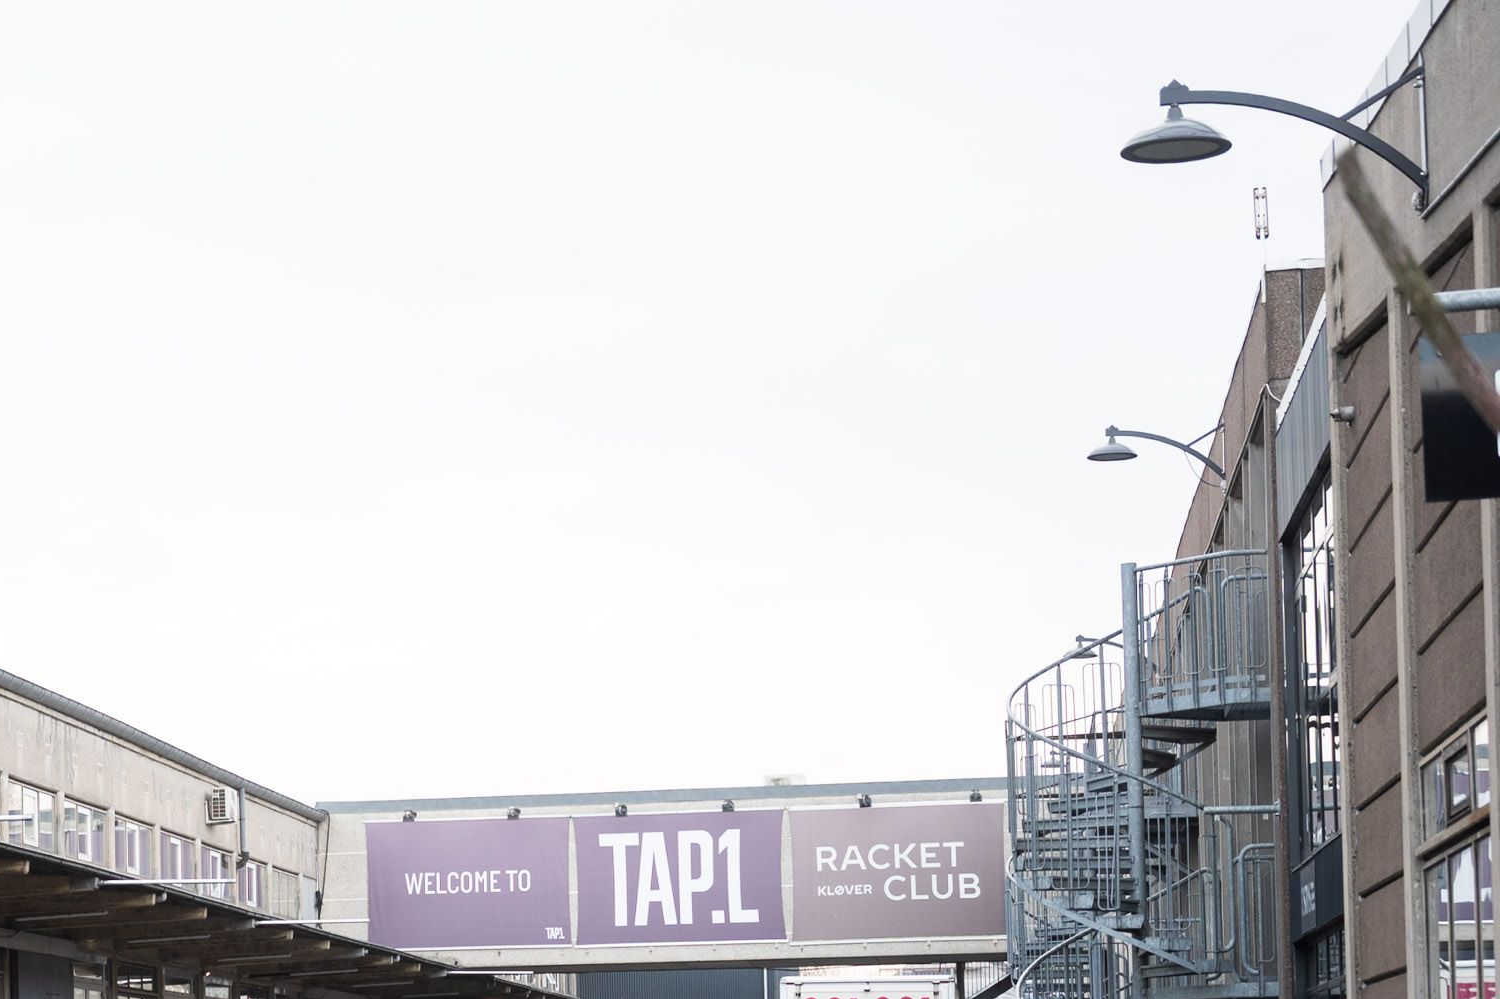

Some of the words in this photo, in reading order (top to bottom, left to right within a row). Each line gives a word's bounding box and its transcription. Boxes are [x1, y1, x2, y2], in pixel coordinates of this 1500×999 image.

[815, 841, 964, 872] RACKET
[404, 870, 501, 894] WELCOME
[505, 869, 531, 892] TO
[598, 829, 759, 927] TAP.1
[817, 884, 873, 896] KLØVER
[883, 873, 981, 901] CLUB
